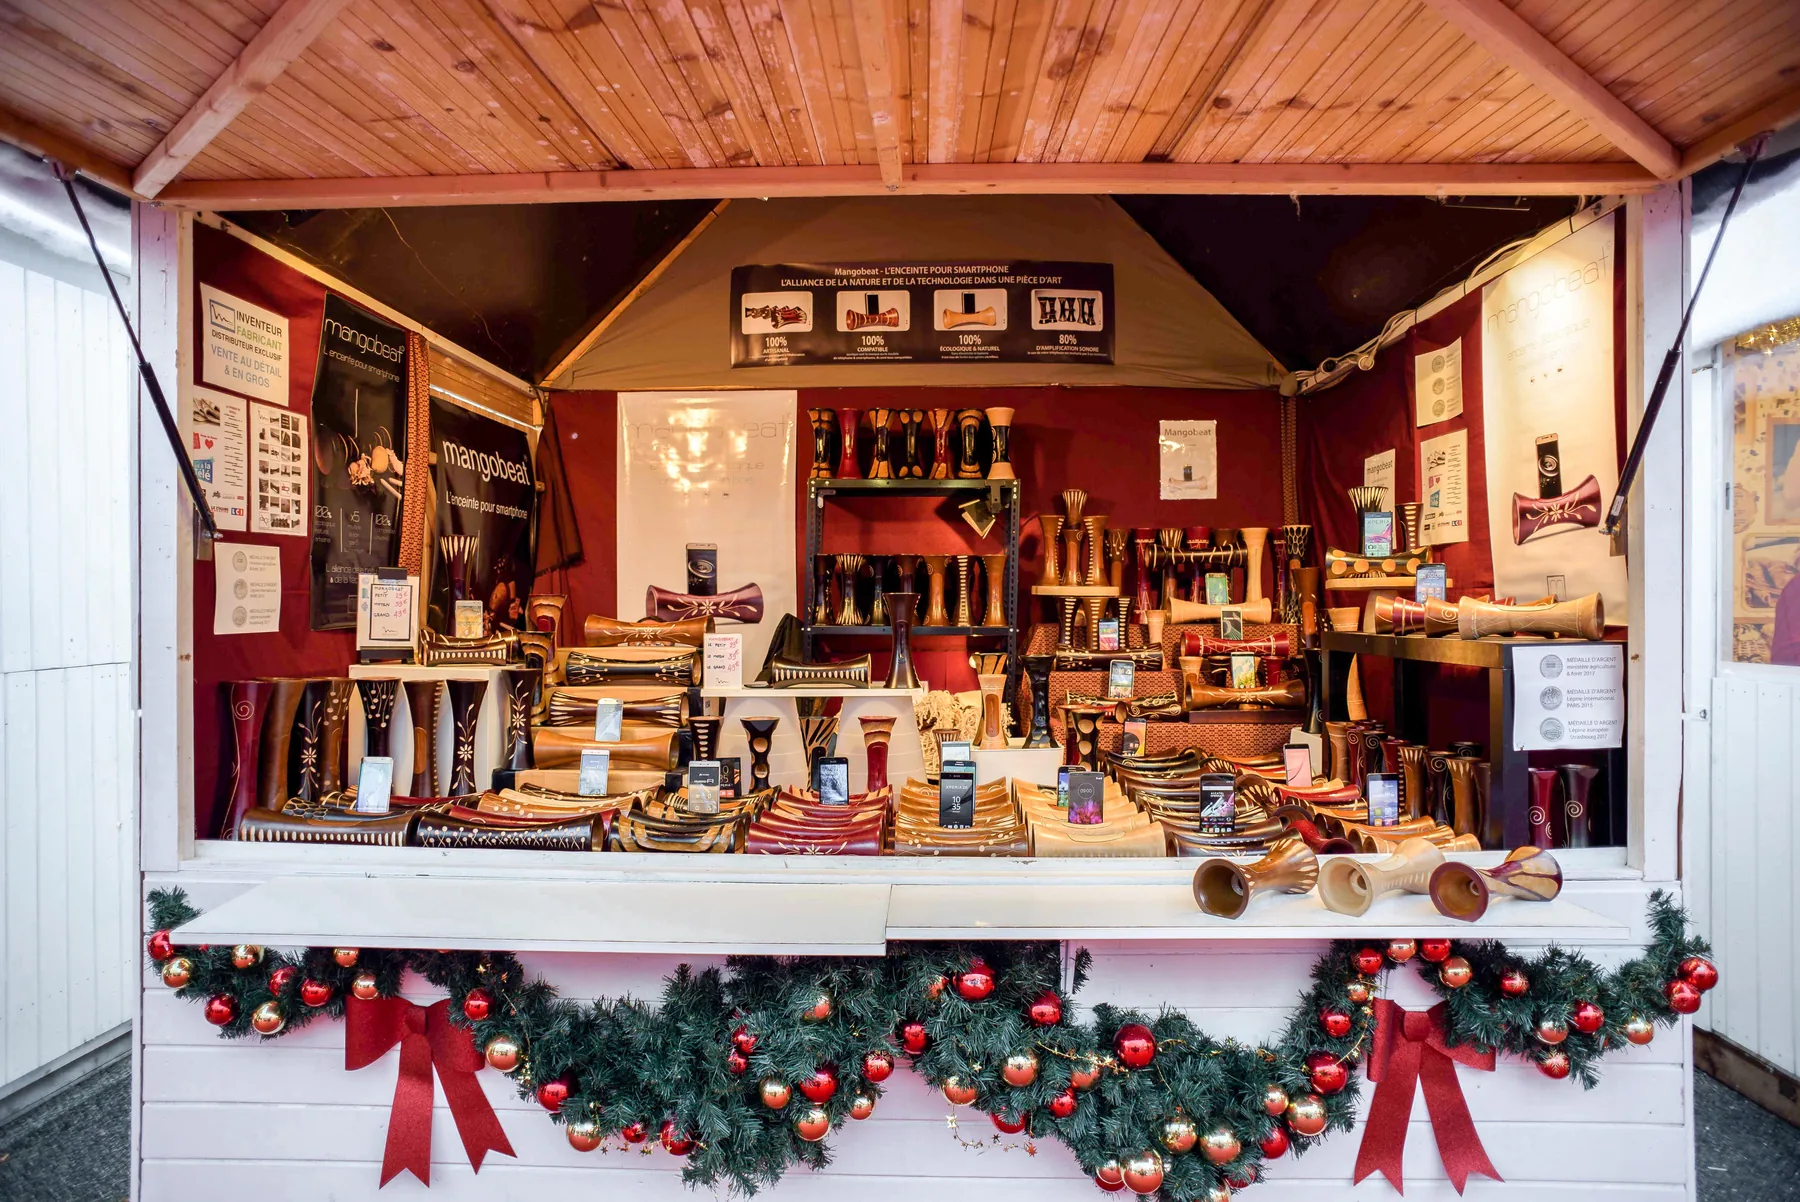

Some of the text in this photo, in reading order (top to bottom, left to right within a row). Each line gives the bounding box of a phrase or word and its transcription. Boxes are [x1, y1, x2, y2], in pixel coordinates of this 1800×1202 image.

[781, 279, 824, 287] L'ALLIANCE
[916, 277, 973, 285] TECHNOLOGIE
[998, 276, 1015, 284] UNE
[1016, 274, 1038, 284] PIÈCE
[1039, 276, 1062, 284] D'ART
[834, 267, 879, 278] Mangobeat
[884, 266, 928, 275] L'ENCEINTE
[953, 265, 1009, 273] SMARTPHONE
[236, 310, 282, 338] INVENTEUR
[211, 329, 282, 361] DISTRIBUTEUR EXCLUSIF
[236, 326, 282, 352] FABRICANT
[766, 337, 788, 347] 100%
[862, 335, 884, 346] 100%
[959, 334, 982, 345] 100%
[1059, 334, 1077, 344] 80%
[211, 344, 282, 378] VENTE AU DÉTAIL
[224, 364, 270, 388] & EN GROS
[1164, 428, 1212, 437] Mangobeat
[442, 440, 531, 485] mangobeat
[446, 490, 528, 519] L'enceinte pour smartphone
